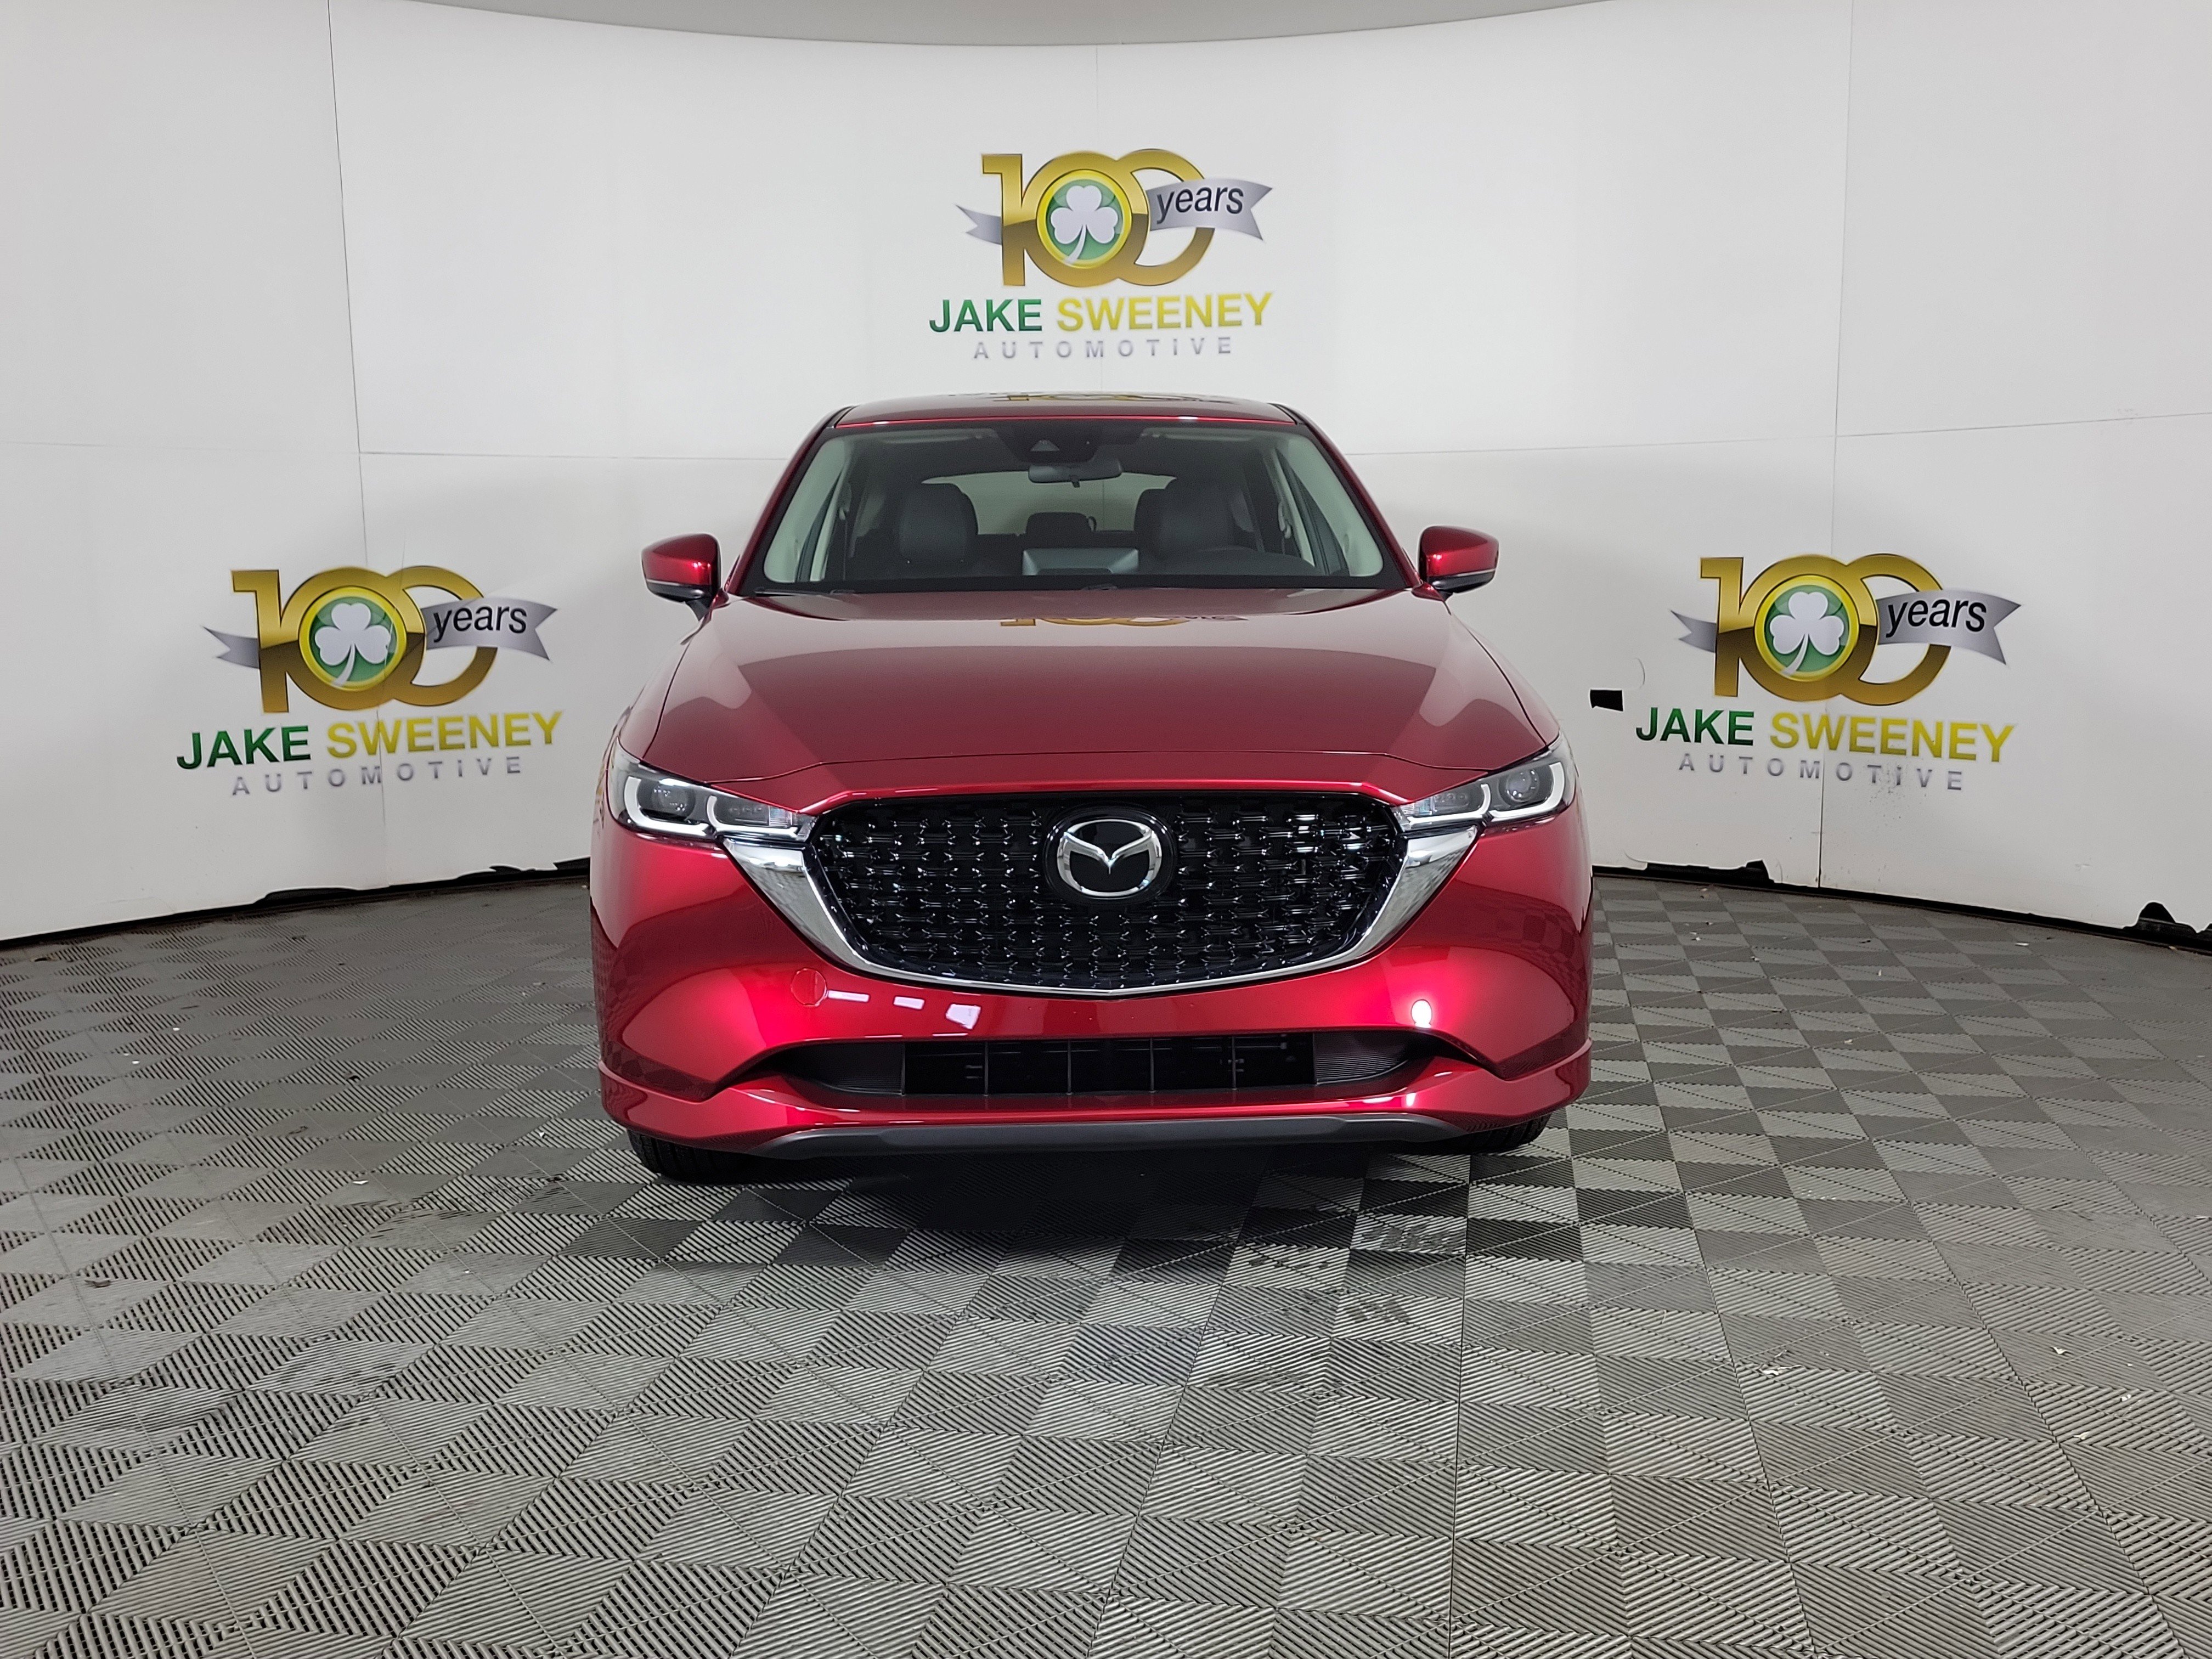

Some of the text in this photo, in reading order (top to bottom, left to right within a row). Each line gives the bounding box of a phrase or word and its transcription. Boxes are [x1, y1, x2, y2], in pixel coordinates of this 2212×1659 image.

[981, 148, 1244, 287] 100 years
[929, 292, 1272, 332] JAKE SWEENEY
[974, 336, 1231, 359] AUTOMOTIVE
[232, 565, 527, 713] 100 years
[1701, 553, 1987, 706] 100 years
[176, 711, 563, 769] JAKE SWEENEY
[1635, 707, 2015, 763] JAKE SWEENEY
[232, 757, 521, 795] AUTOMOTIVE
[1679, 753, 1962, 791] AUTOMOTIVE
